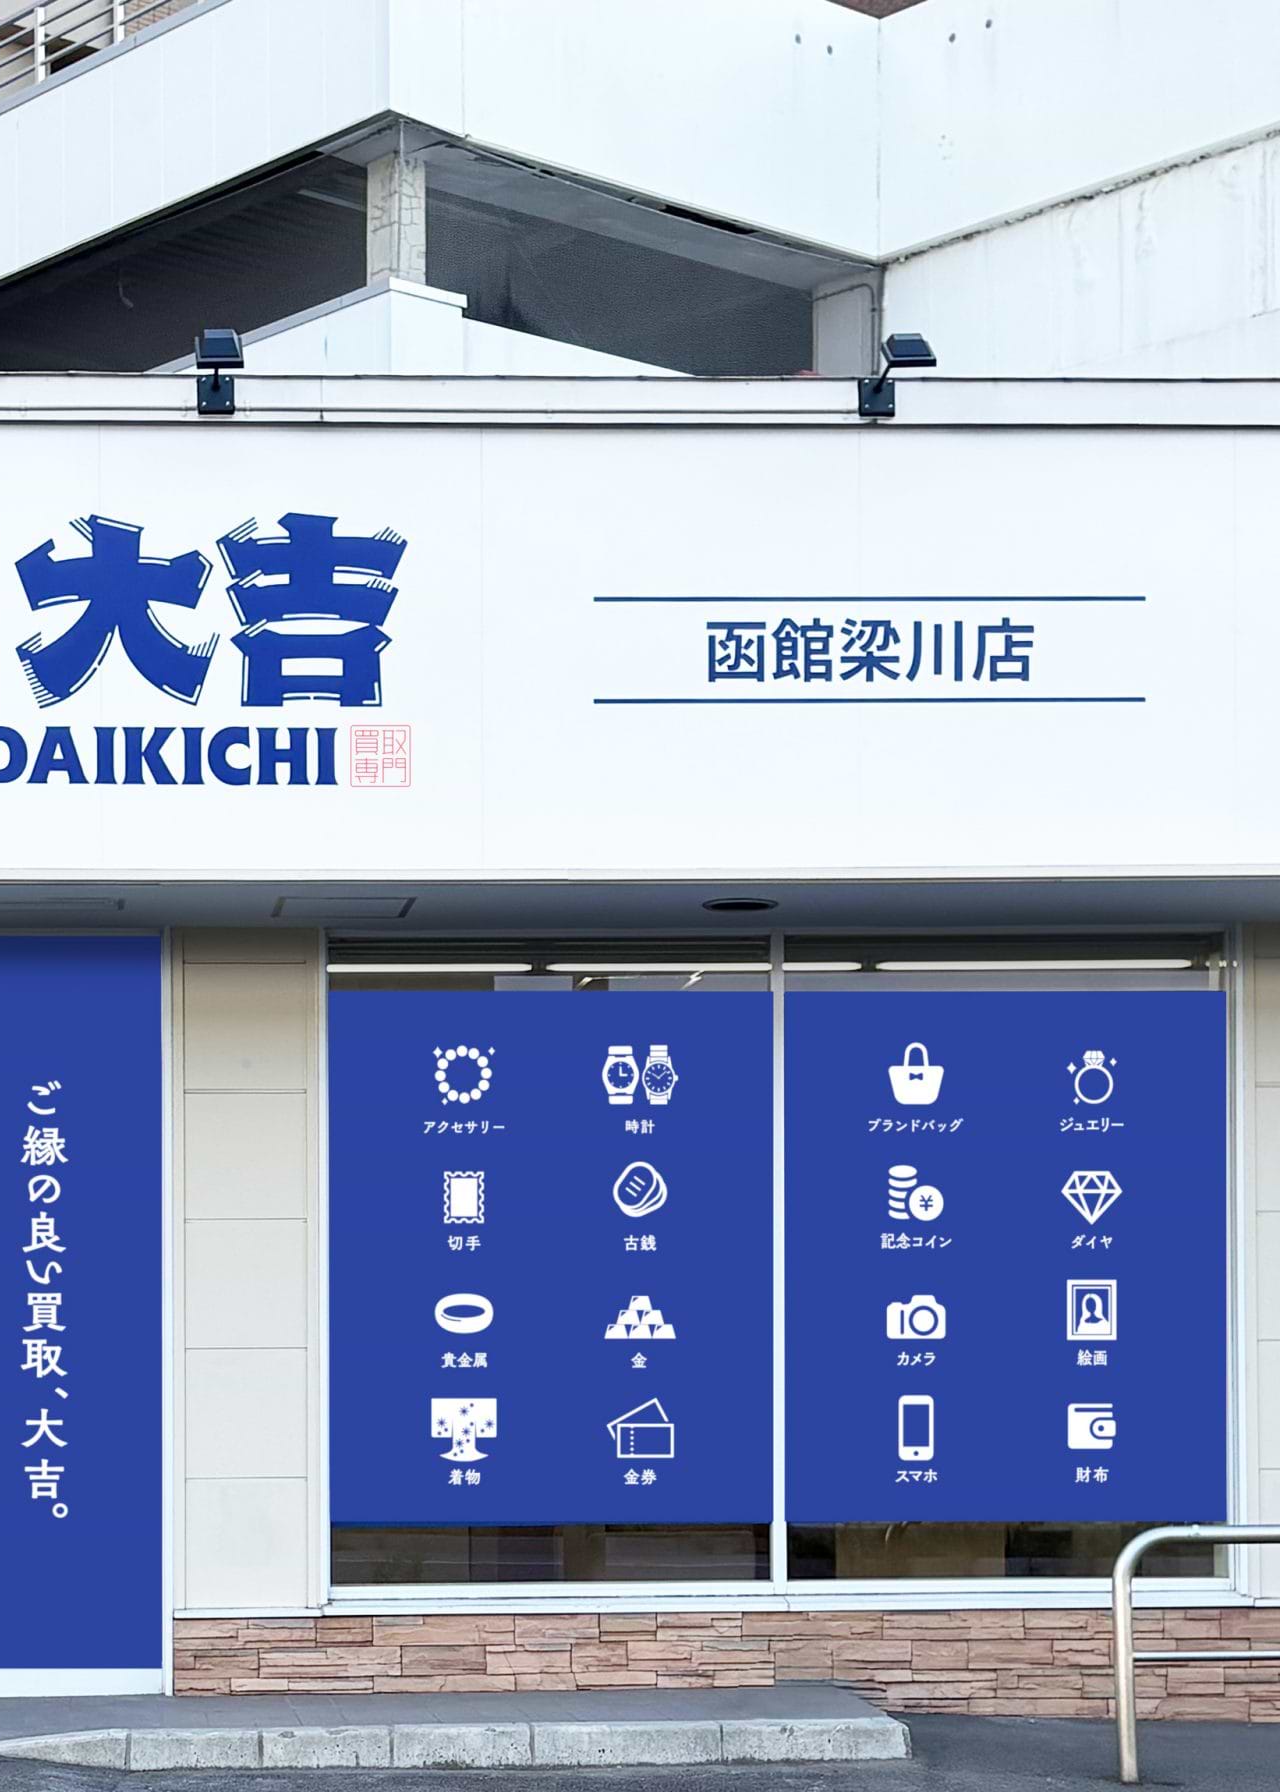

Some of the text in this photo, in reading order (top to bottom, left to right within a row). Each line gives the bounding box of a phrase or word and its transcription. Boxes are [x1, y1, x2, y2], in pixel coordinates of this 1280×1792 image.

[706, 616, 1035, 683] 函館梁川店
[422, 1120, 506, 1134] アクセサリー
[624, 1118, 656, 1135] 時計
[867, 1117, 965, 1133] ブランドバッグ
[1059, 1117, 1125, 1133] ジュエリー
[447, 1235, 482, 1252] 切手
[623, 1234, 658, 1252] 古銭
[880, 1232, 953, 1250] 記念コイン
[1070, 1233, 1114, 1250] ダイヤ
[20, 1079, 70, 1519] ご縁の良い買取、大吉。
[440, 1351, 488, 1369] 貴金属
[630, 1352, 648, 1369] 金
[896, 1350, 937, 1367] カメラ
[1076, 1349, 1108, 1367] 絵画
[447, 1468, 482, 1486] 着物
[623, 1468, 657, 1486] 金券
[894, 1467, 939, 1484] スマホ
[1074, 1466, 1109, 1484] 財布
